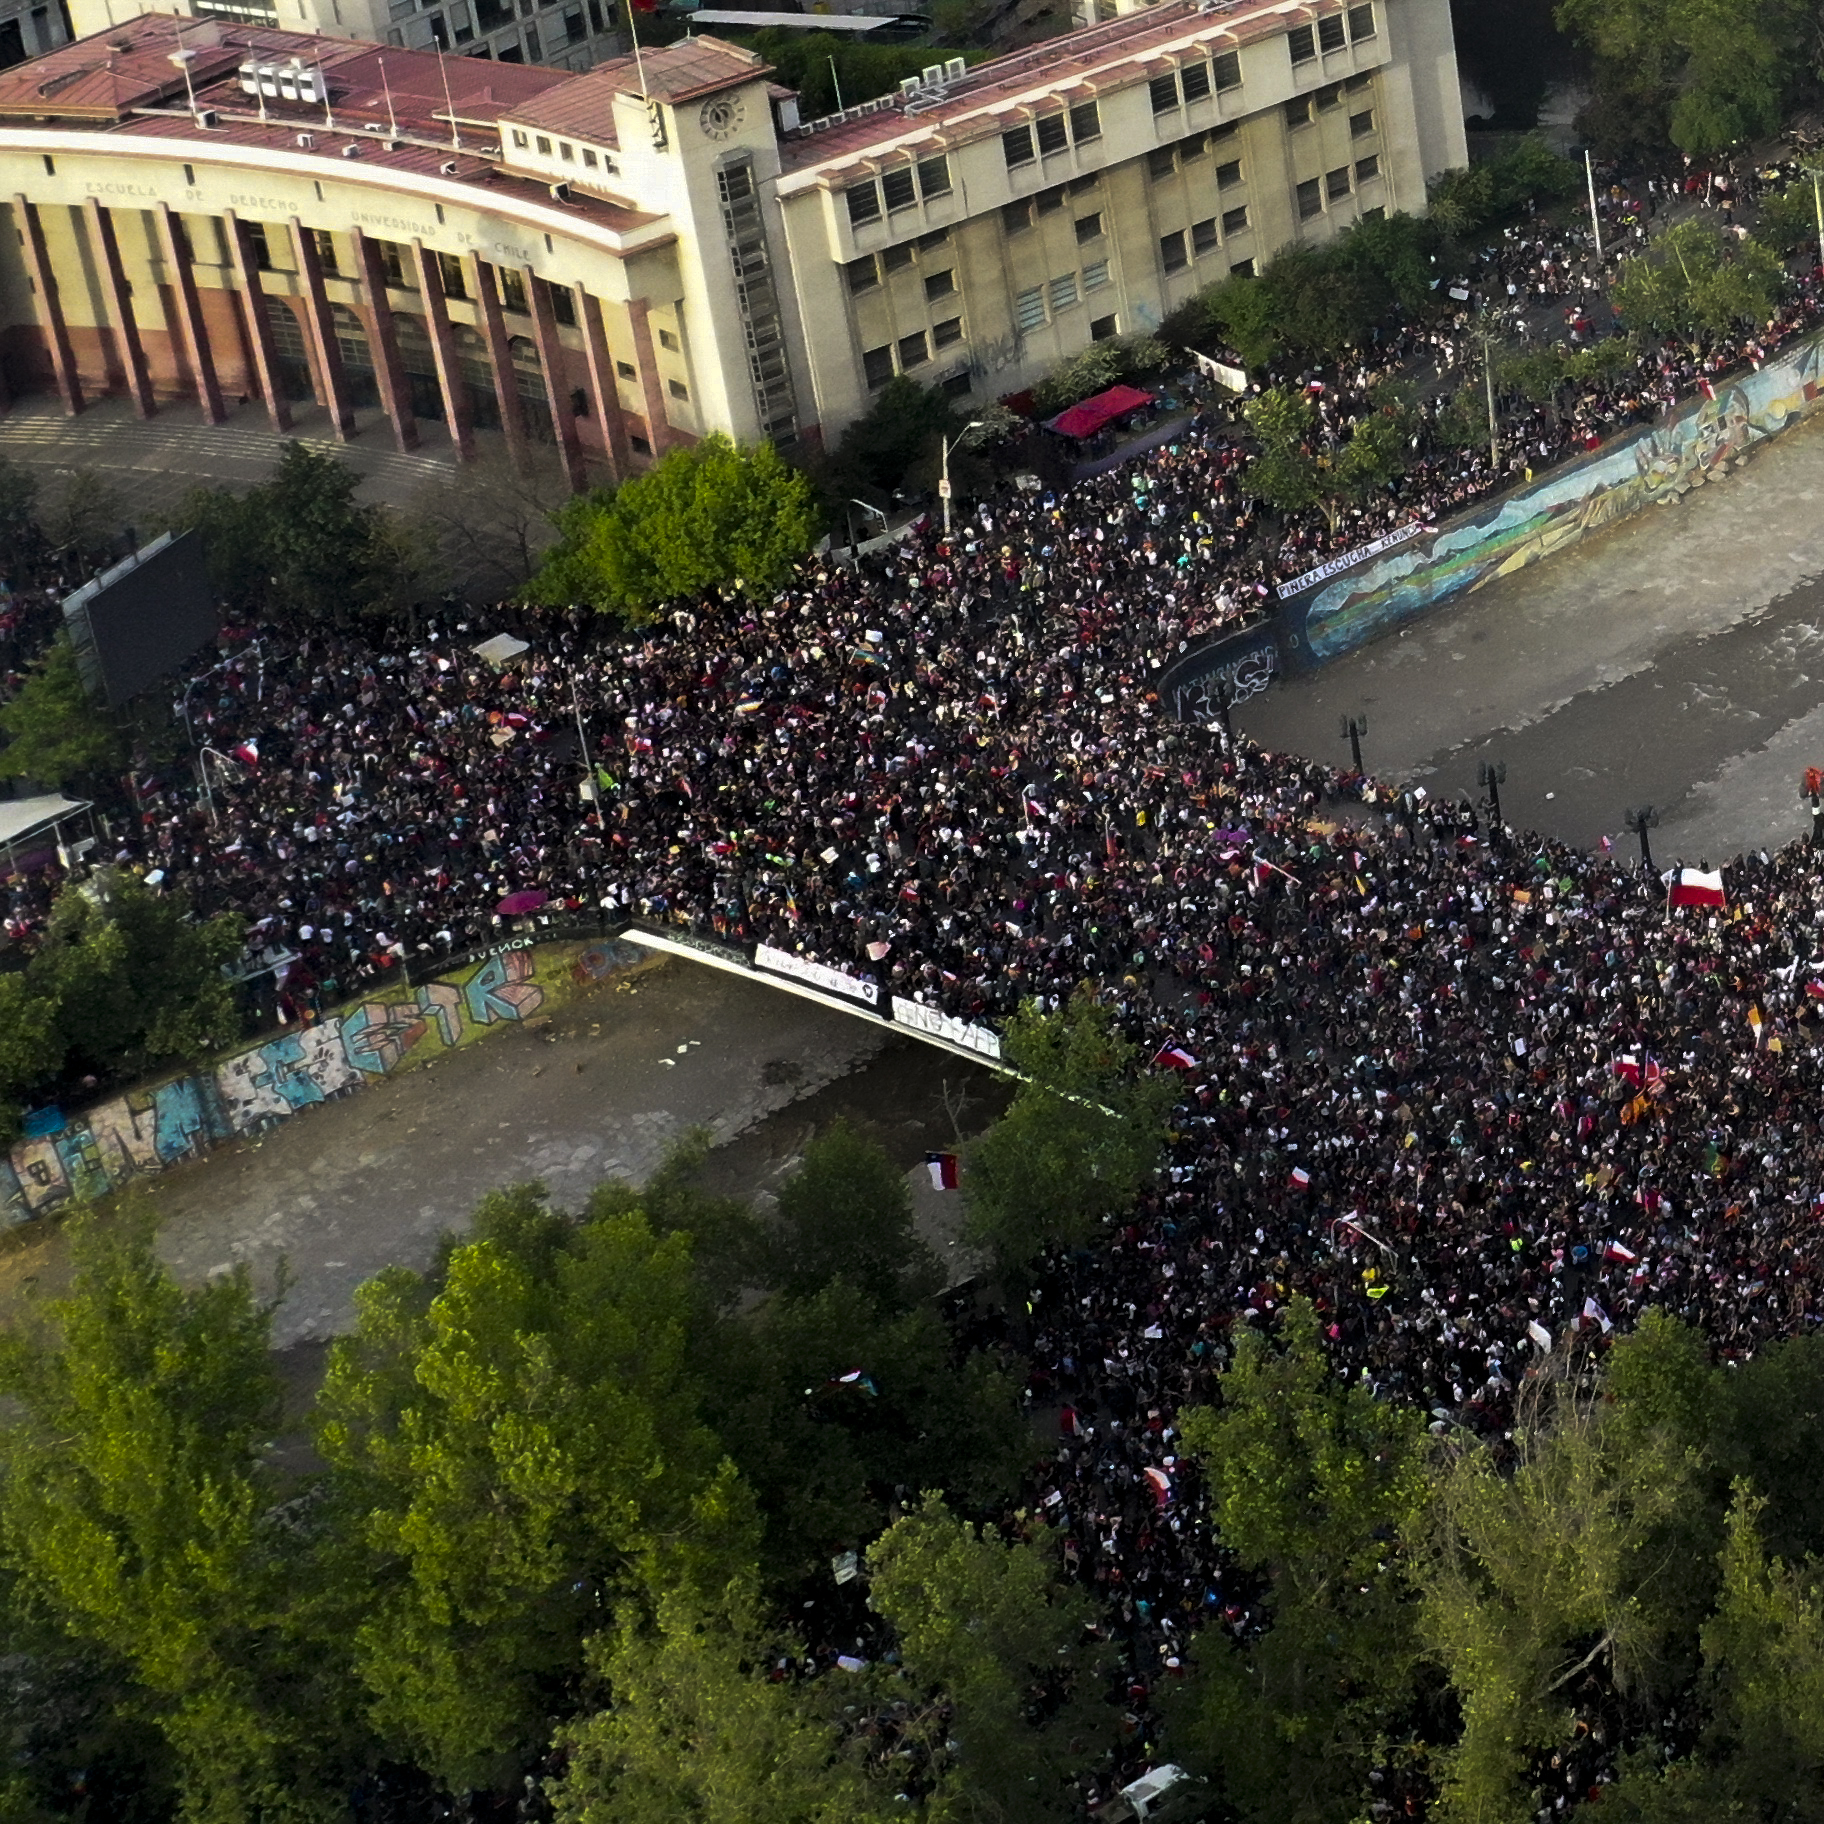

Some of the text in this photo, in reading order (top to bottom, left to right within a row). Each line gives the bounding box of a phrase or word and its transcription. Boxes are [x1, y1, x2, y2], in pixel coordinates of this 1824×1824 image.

[85, 182, 530, 261] ESCUELA DE DERECHO UNIVERSIDAD DE CHILE
[1323, 546, 1373, 577] ESCUCHA
